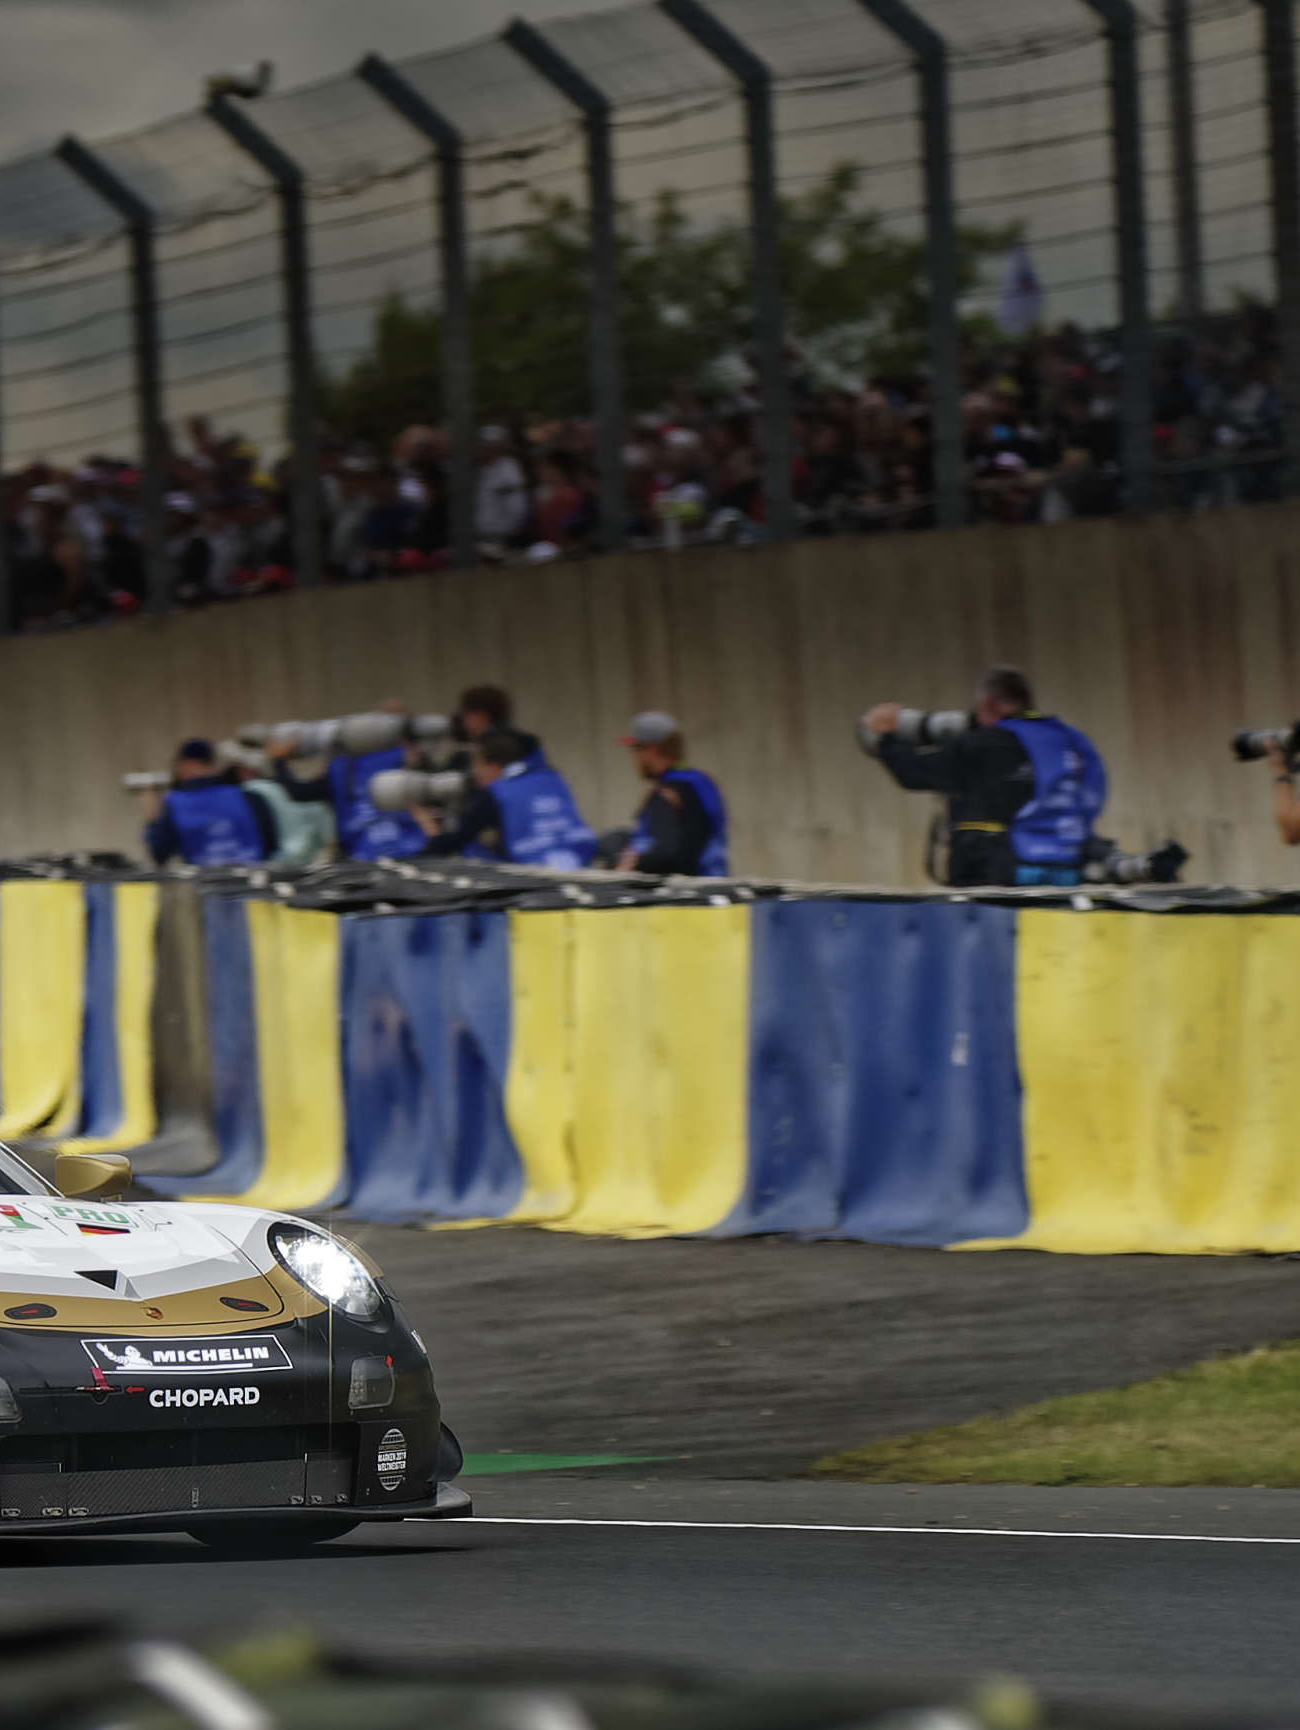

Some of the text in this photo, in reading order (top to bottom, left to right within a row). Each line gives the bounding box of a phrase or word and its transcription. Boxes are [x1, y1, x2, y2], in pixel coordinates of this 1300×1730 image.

[51, 1206, 130, 1224] PRO
[152, 1347, 270, 1363] MICHELIN
[150, 1387, 260, 1408] CHOPARD
